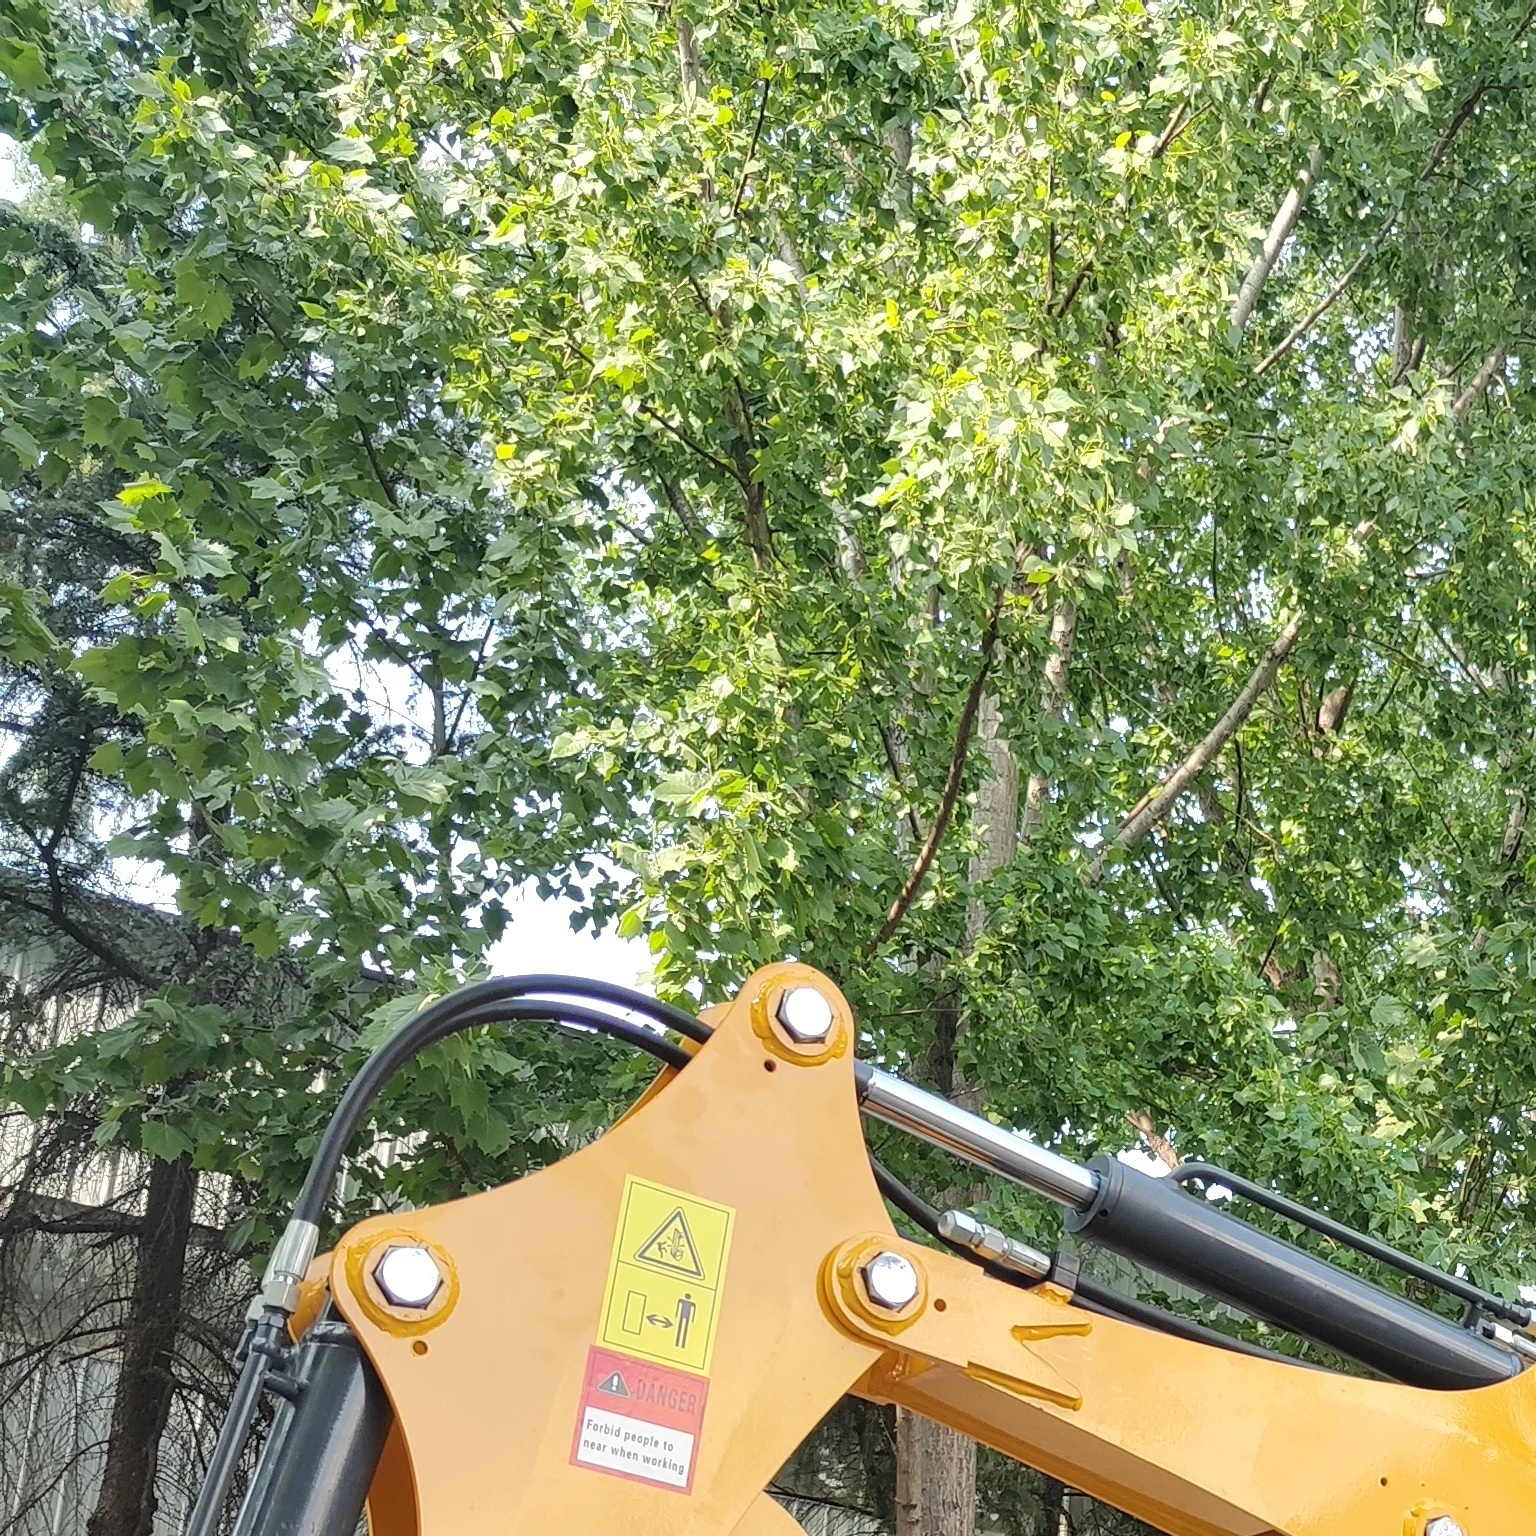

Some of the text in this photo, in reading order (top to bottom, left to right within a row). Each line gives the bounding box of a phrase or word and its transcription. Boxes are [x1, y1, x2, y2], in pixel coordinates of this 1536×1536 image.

[636, 1378, 697, 1416] DANGER
[586, 1418, 674, 1452] Forbid people to
[583, 1439, 685, 1476] near when working
